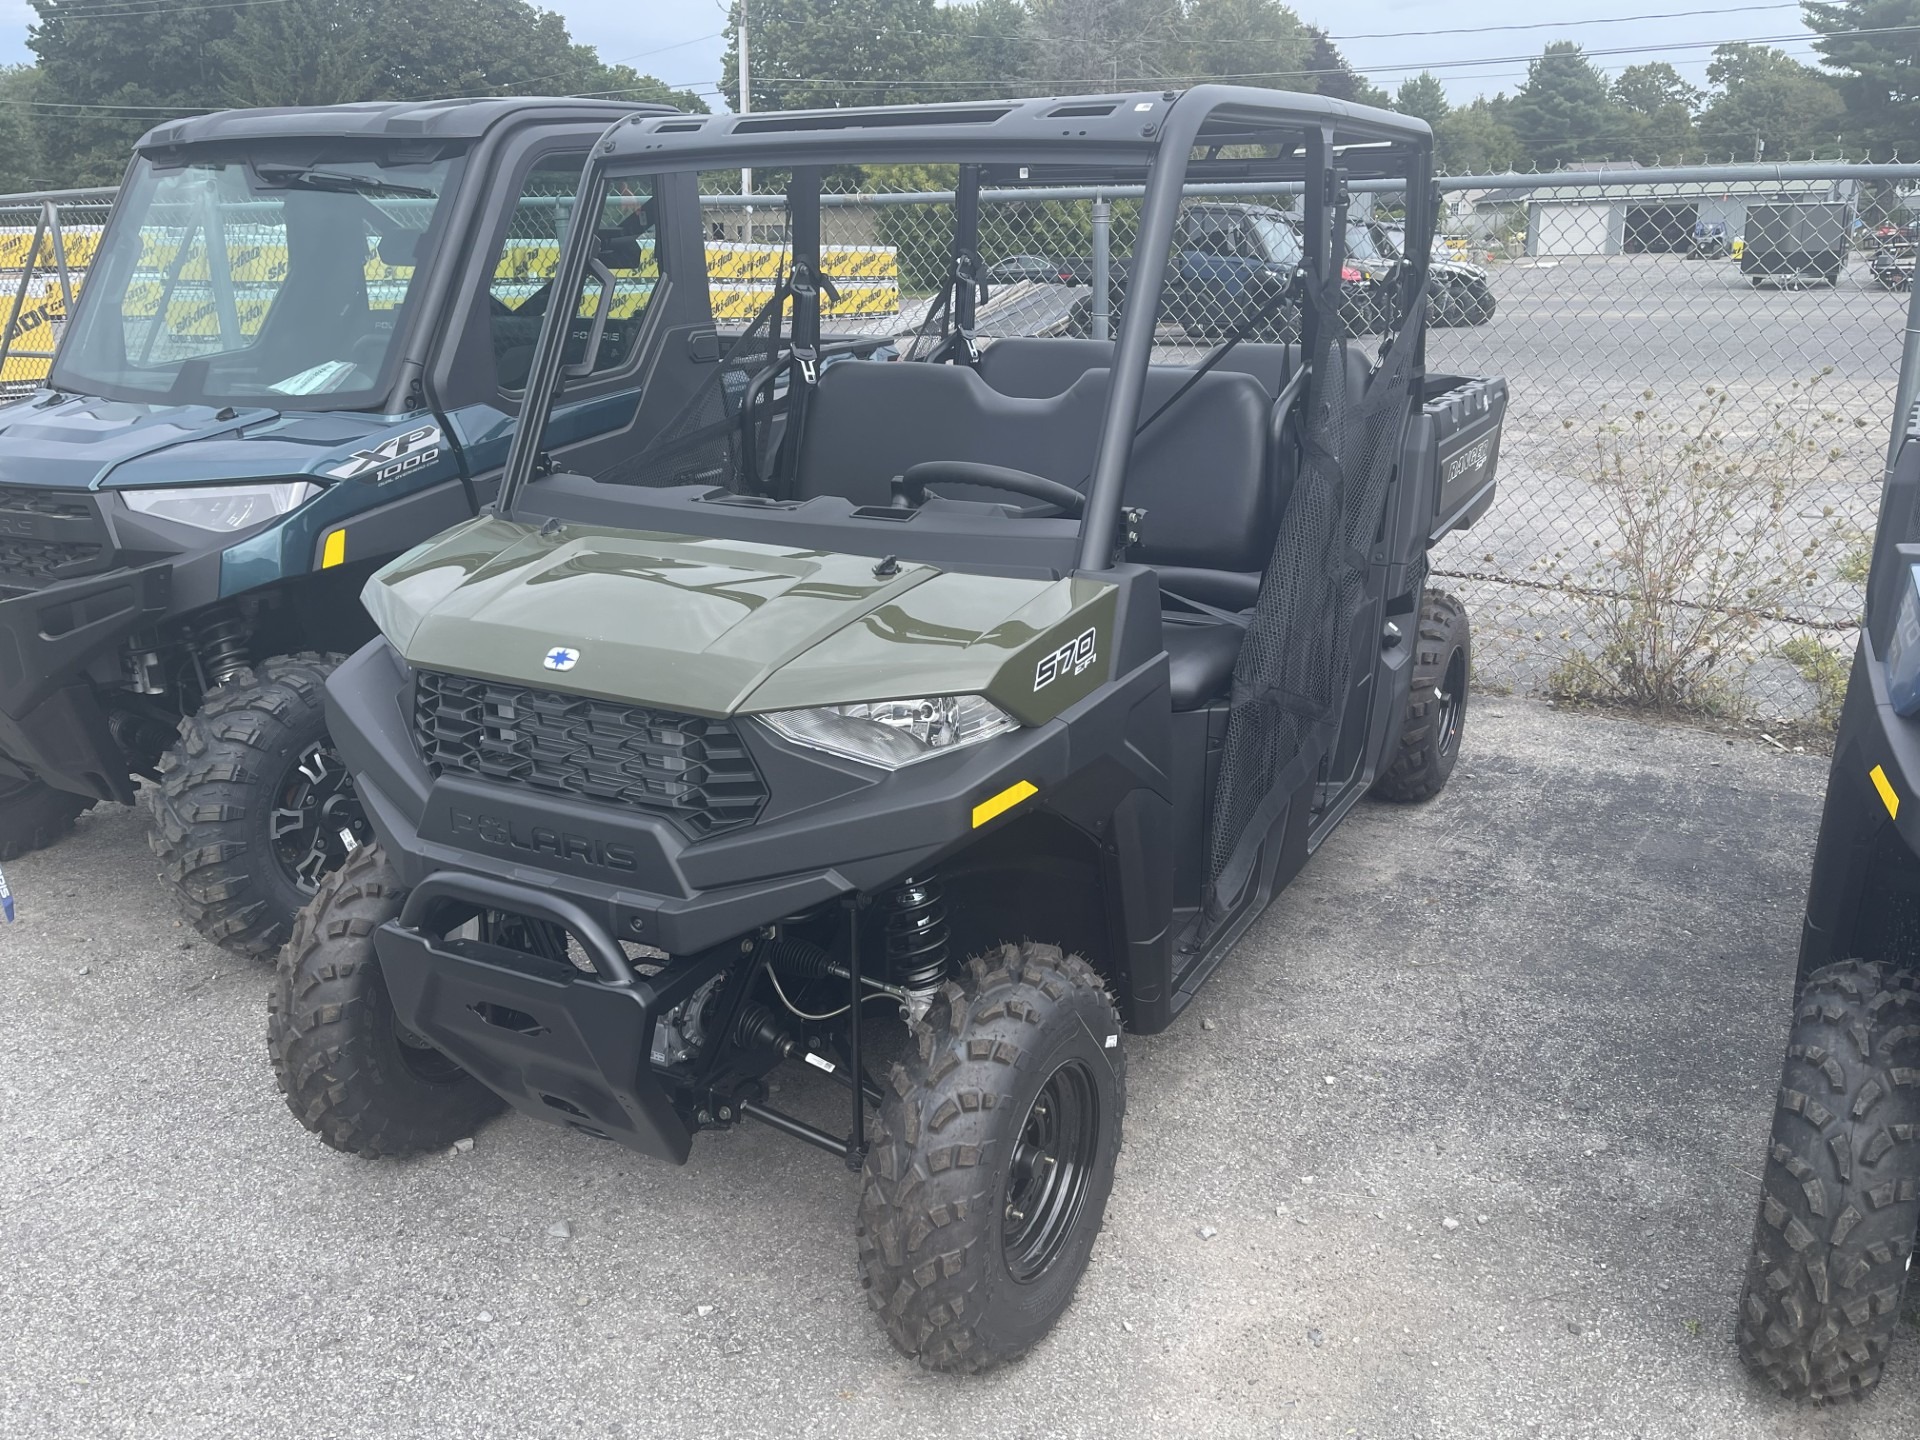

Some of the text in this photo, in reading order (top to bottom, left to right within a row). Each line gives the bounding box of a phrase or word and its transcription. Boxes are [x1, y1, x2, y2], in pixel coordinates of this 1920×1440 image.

[344, 424, 438, 478] XP
[376, 447, 440, 482] 1000
[1033, 626, 1096, 692] 570
[1074, 652, 1097, 676] EFI
[449, 806, 638, 874] POLARIS
